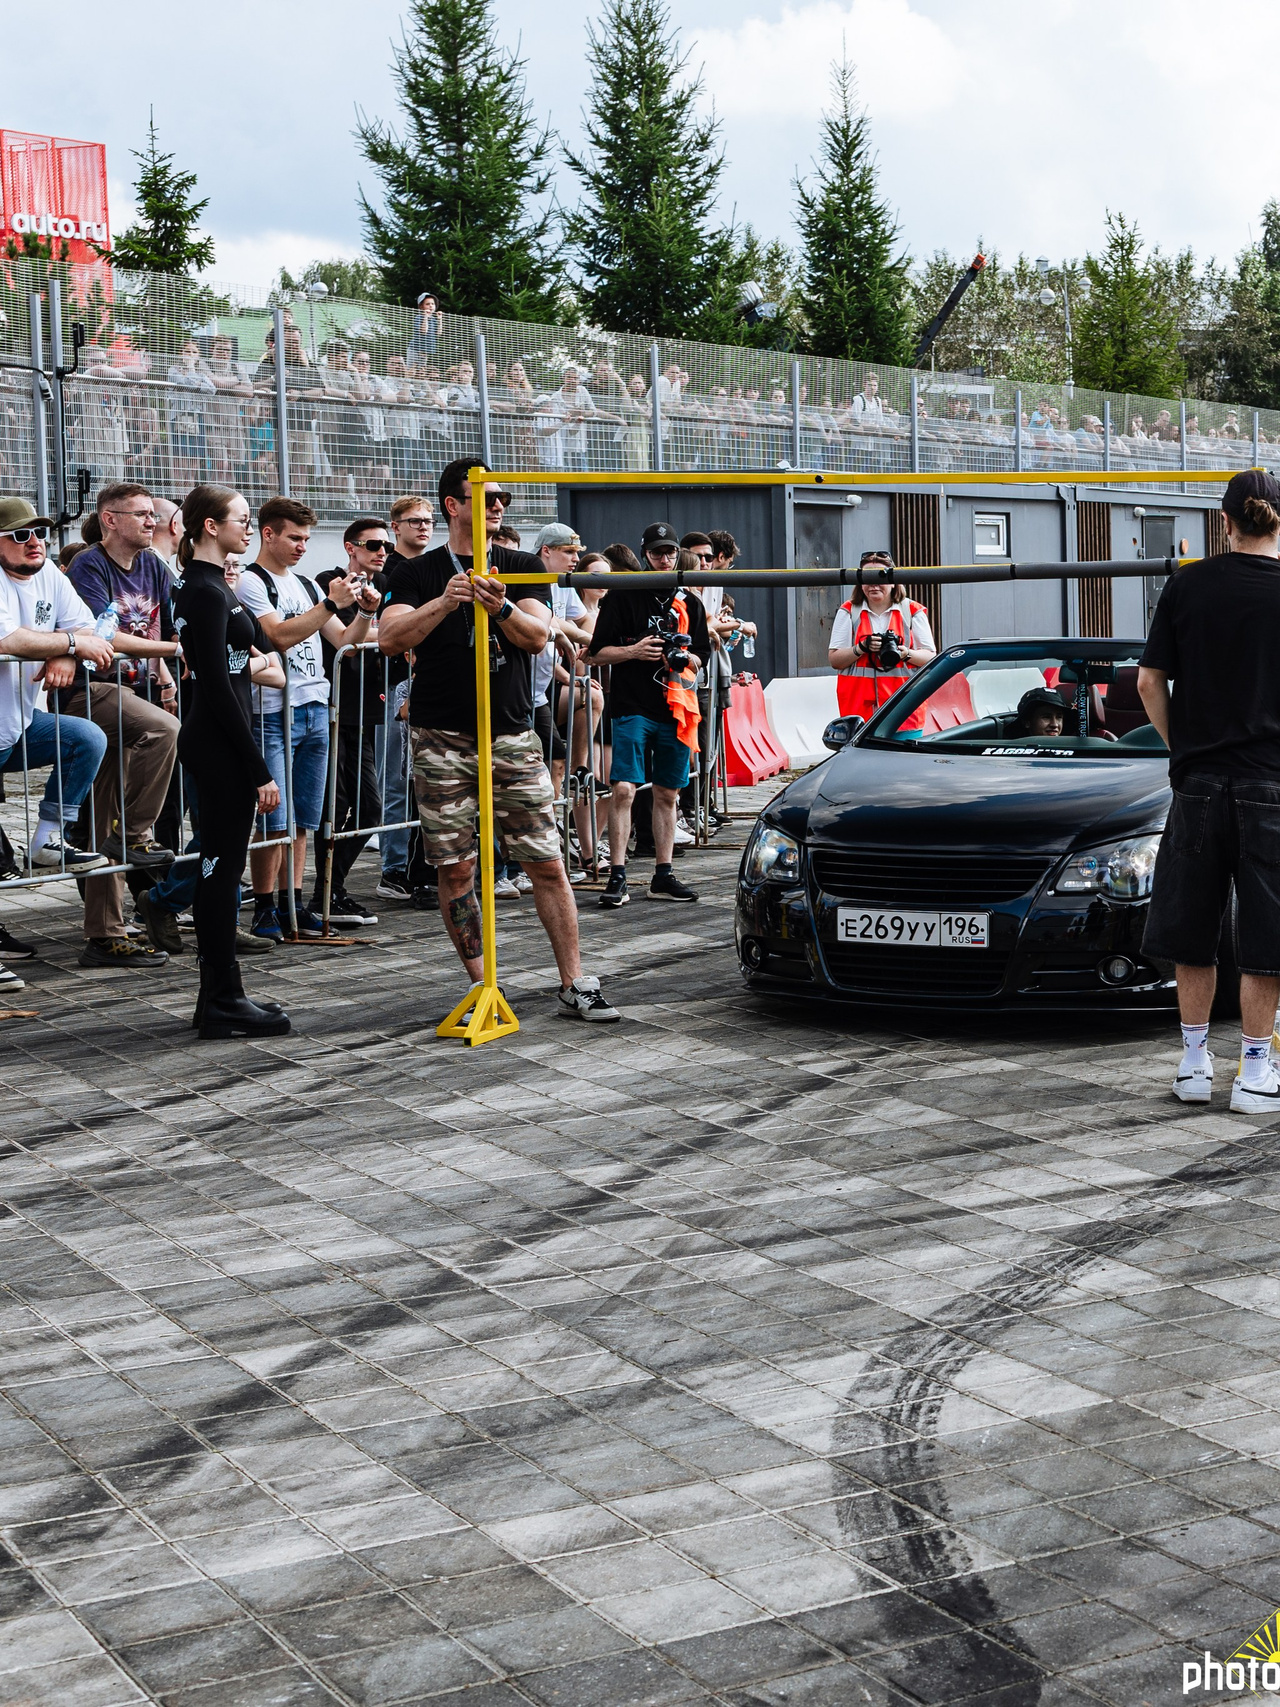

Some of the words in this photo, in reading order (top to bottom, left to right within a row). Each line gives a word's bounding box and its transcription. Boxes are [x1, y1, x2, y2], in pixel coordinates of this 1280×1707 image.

[11, 213, 107, 242] auto.ru
[303, 641, 316, 677] ide
[943, 916, 980, 936] 196
[951, 936, 971, 944] RUS
